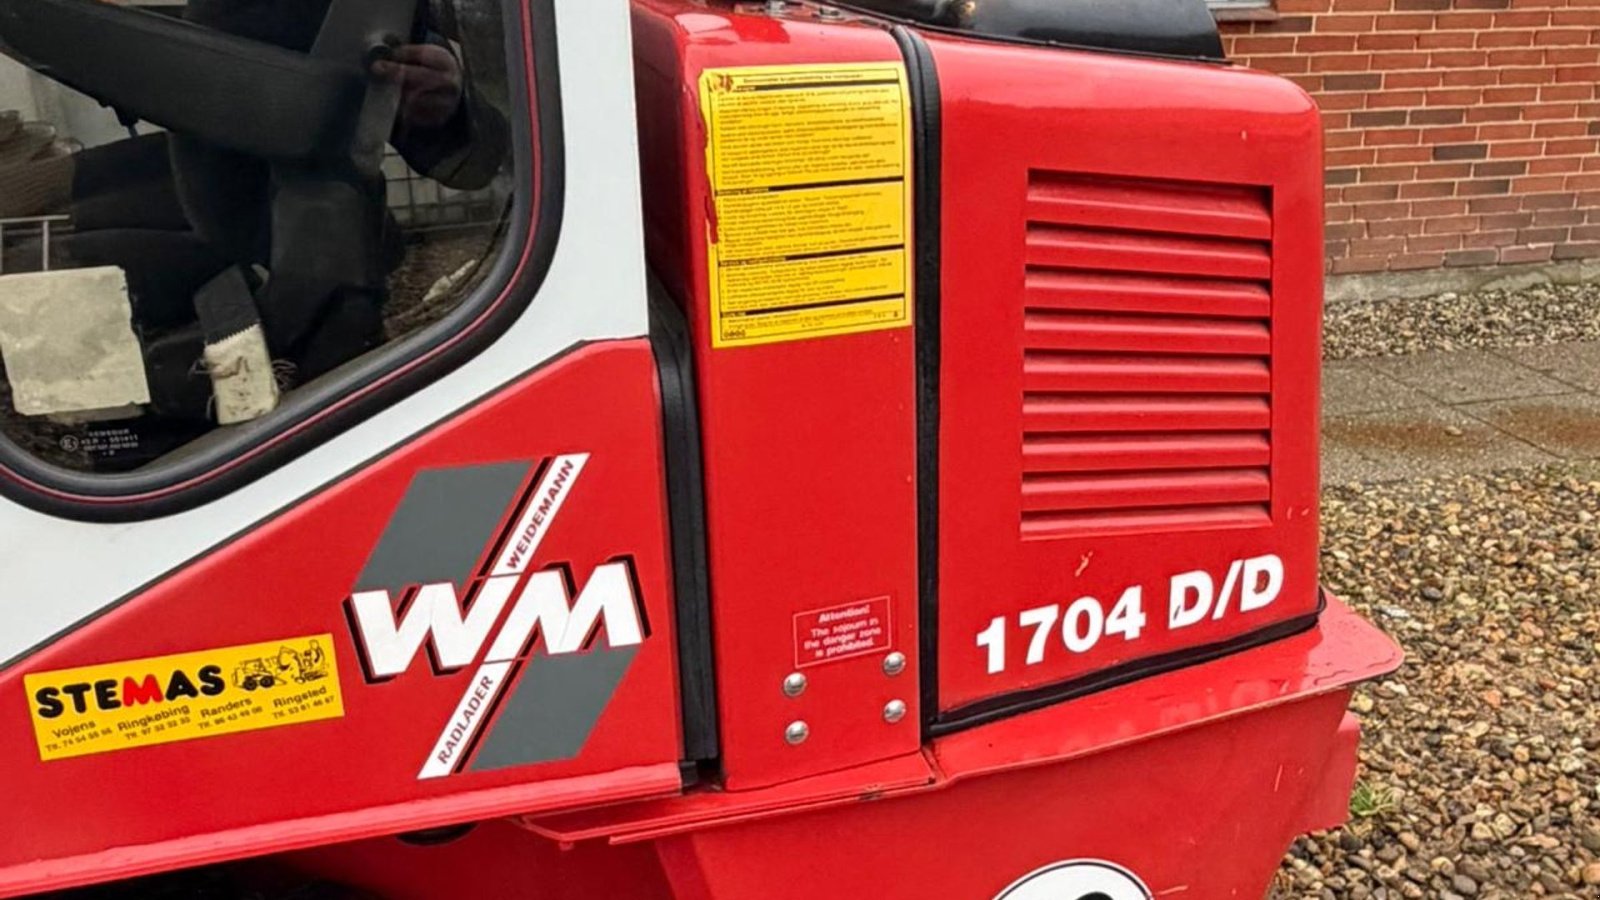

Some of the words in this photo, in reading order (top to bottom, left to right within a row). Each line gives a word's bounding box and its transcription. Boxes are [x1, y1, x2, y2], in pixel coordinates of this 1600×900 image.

[506, 459, 574, 569] WEIDEMANN
[344, 556, 649, 682] WM
[819, 604, 870, 623] Attention!
[976, 585, 1146, 675] 1704
[1168, 554, 1284, 630] D/D
[804, 640, 820, 650] the
[822, 633, 856, 647] danger
[859, 627, 882, 638] zone
[810, 628, 830, 638] The
[869, 618, 879, 627] in
[815, 649, 824, 658] is
[35, 665, 226, 719] STEMAS
[273, 686, 327, 708] Ringsted
[200, 697, 252, 718] Randers
[52, 720, 96, 738] Vojens
[436, 675, 494, 765] RADLADER
